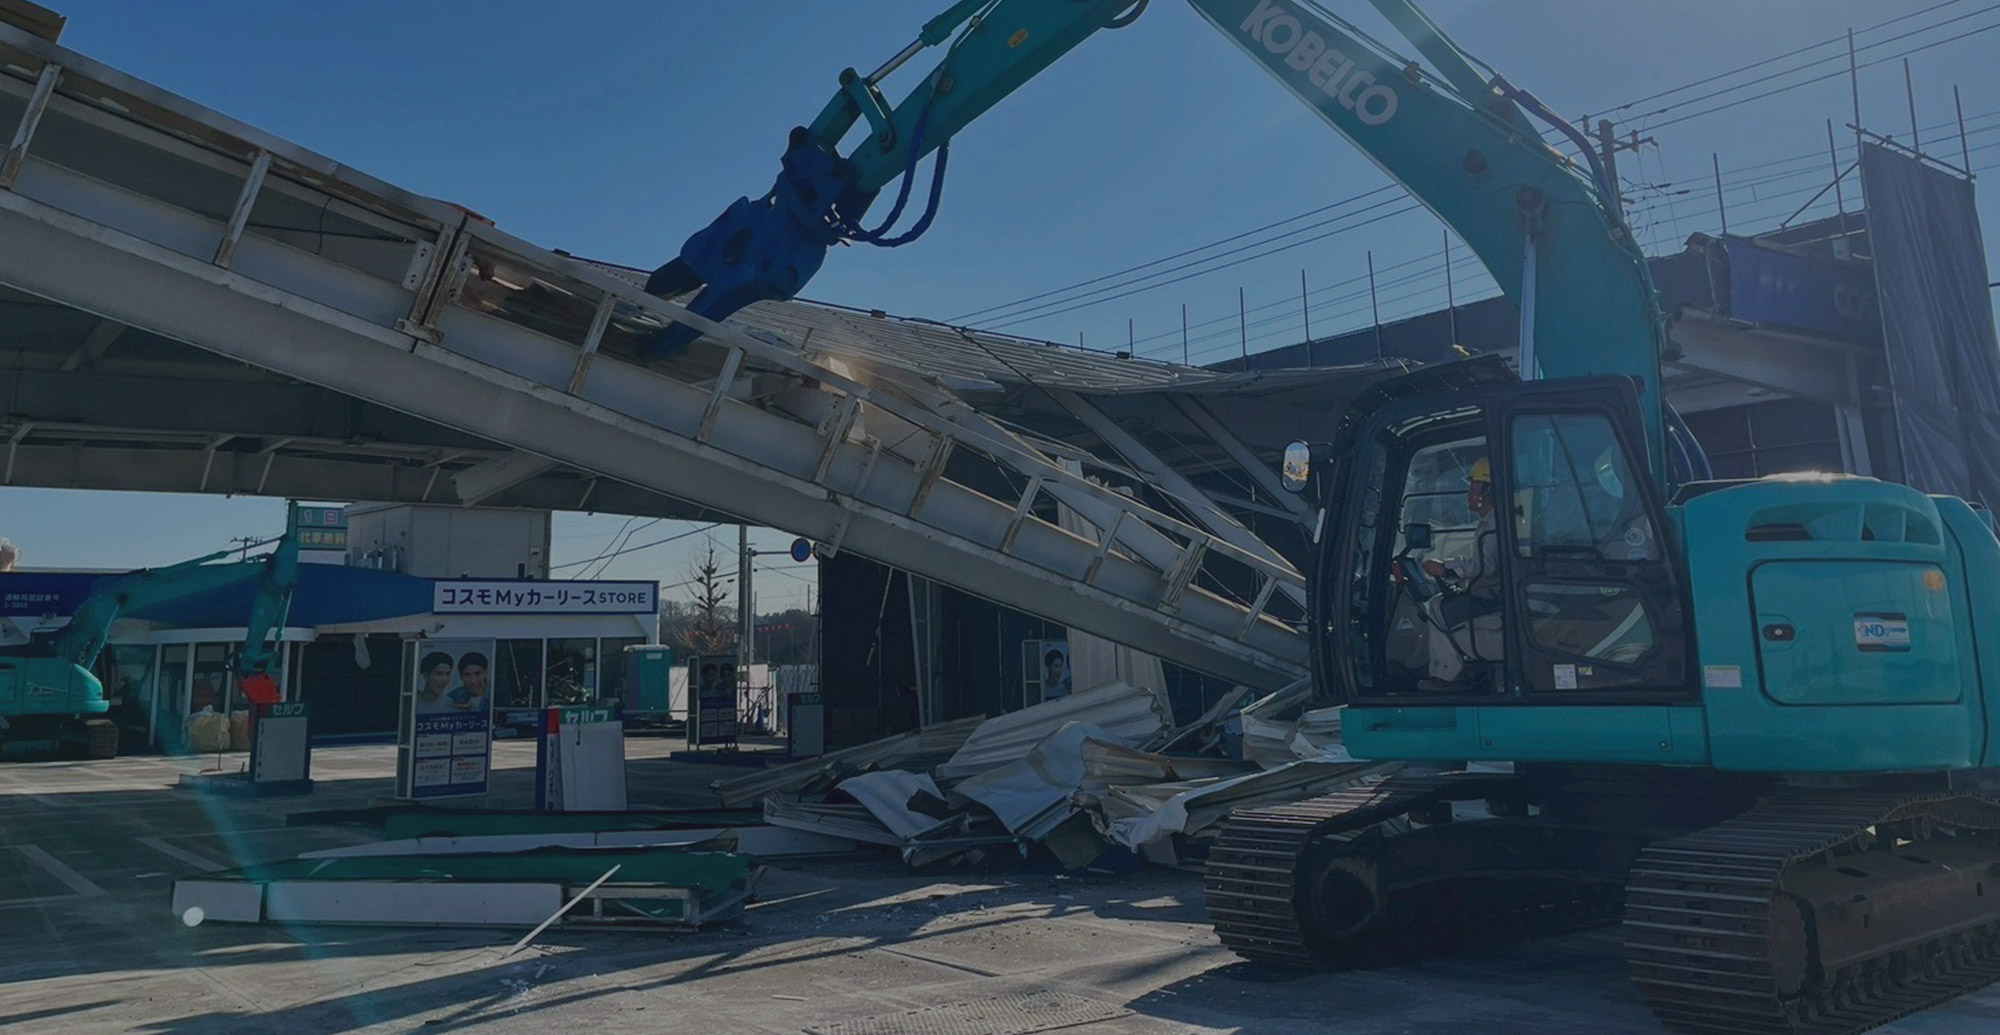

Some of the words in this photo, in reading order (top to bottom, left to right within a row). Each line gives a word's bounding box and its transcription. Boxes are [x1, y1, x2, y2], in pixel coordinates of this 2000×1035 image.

[1239, 0, 1399, 126] KOBELCO
[272, 703, 305, 716] セルフ
[417, 720, 488, 732] コスモMyカーリース
